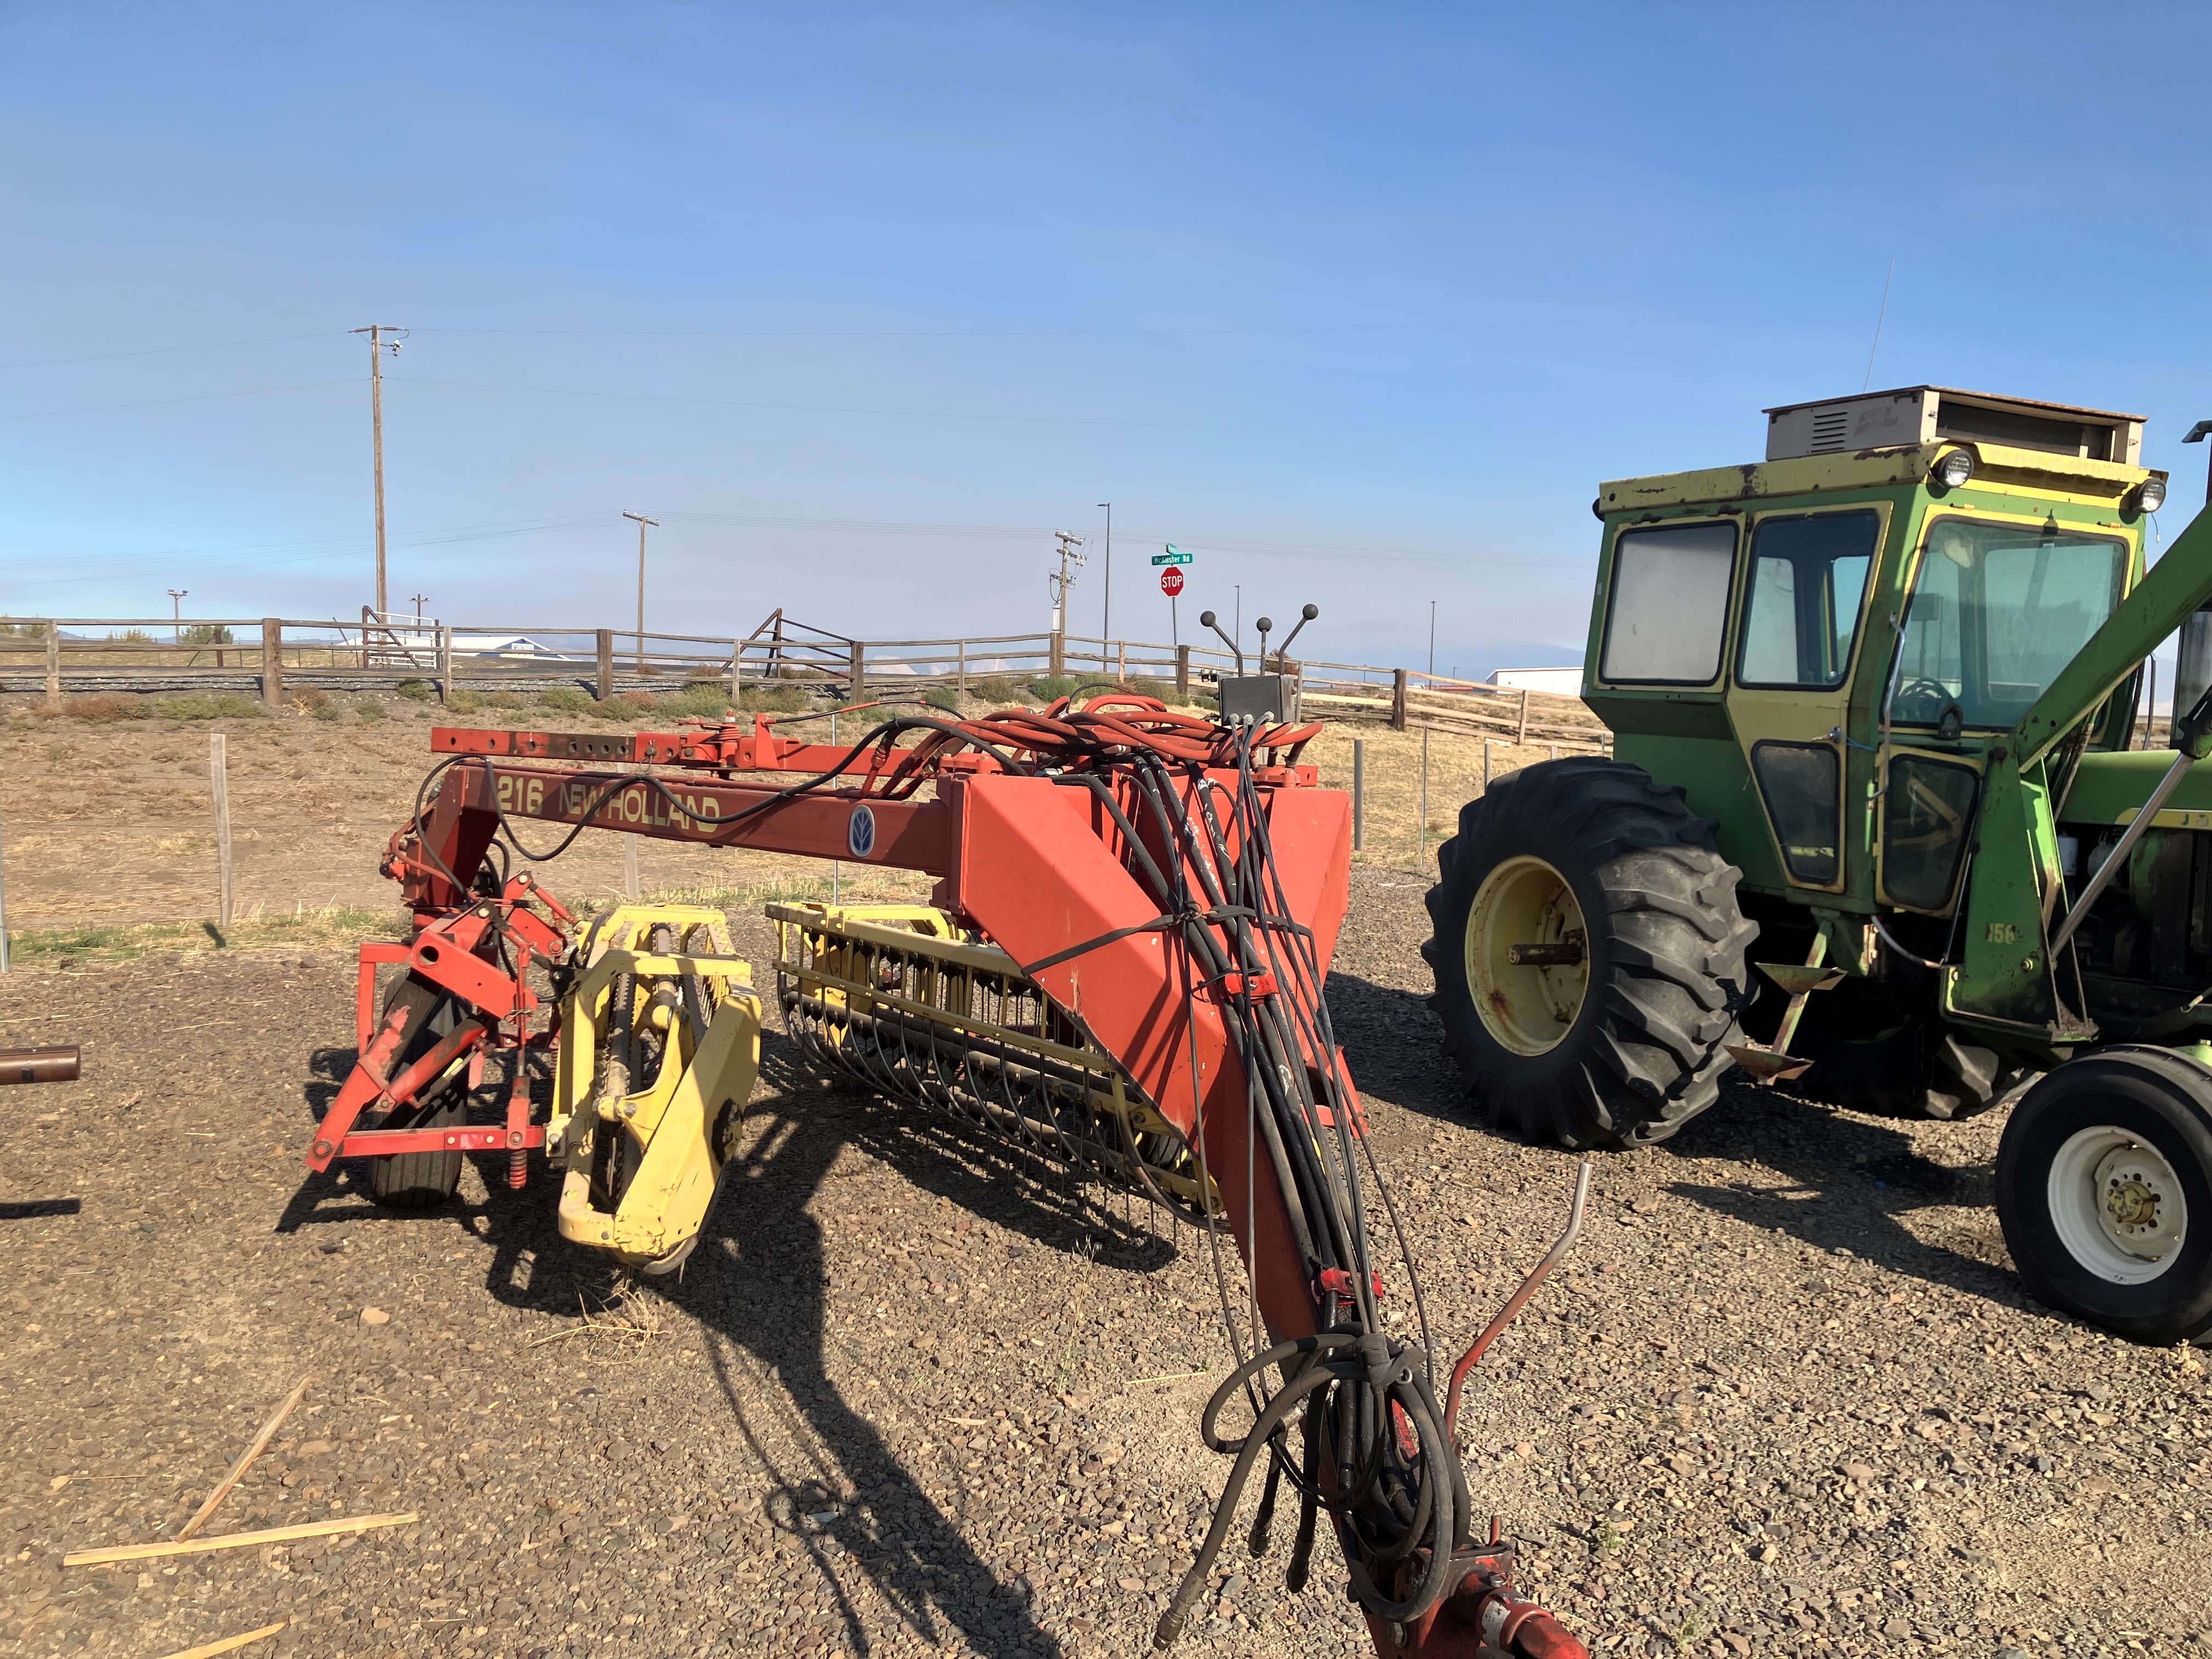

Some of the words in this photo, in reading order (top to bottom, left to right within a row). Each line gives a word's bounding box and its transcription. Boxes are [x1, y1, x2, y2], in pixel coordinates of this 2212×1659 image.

[1162, 575, 1182, 588] STOP
[497, 775, 544, 815] 216
[558, 782, 605, 817] NEW
[608, 788, 720, 833] HOLLAND
